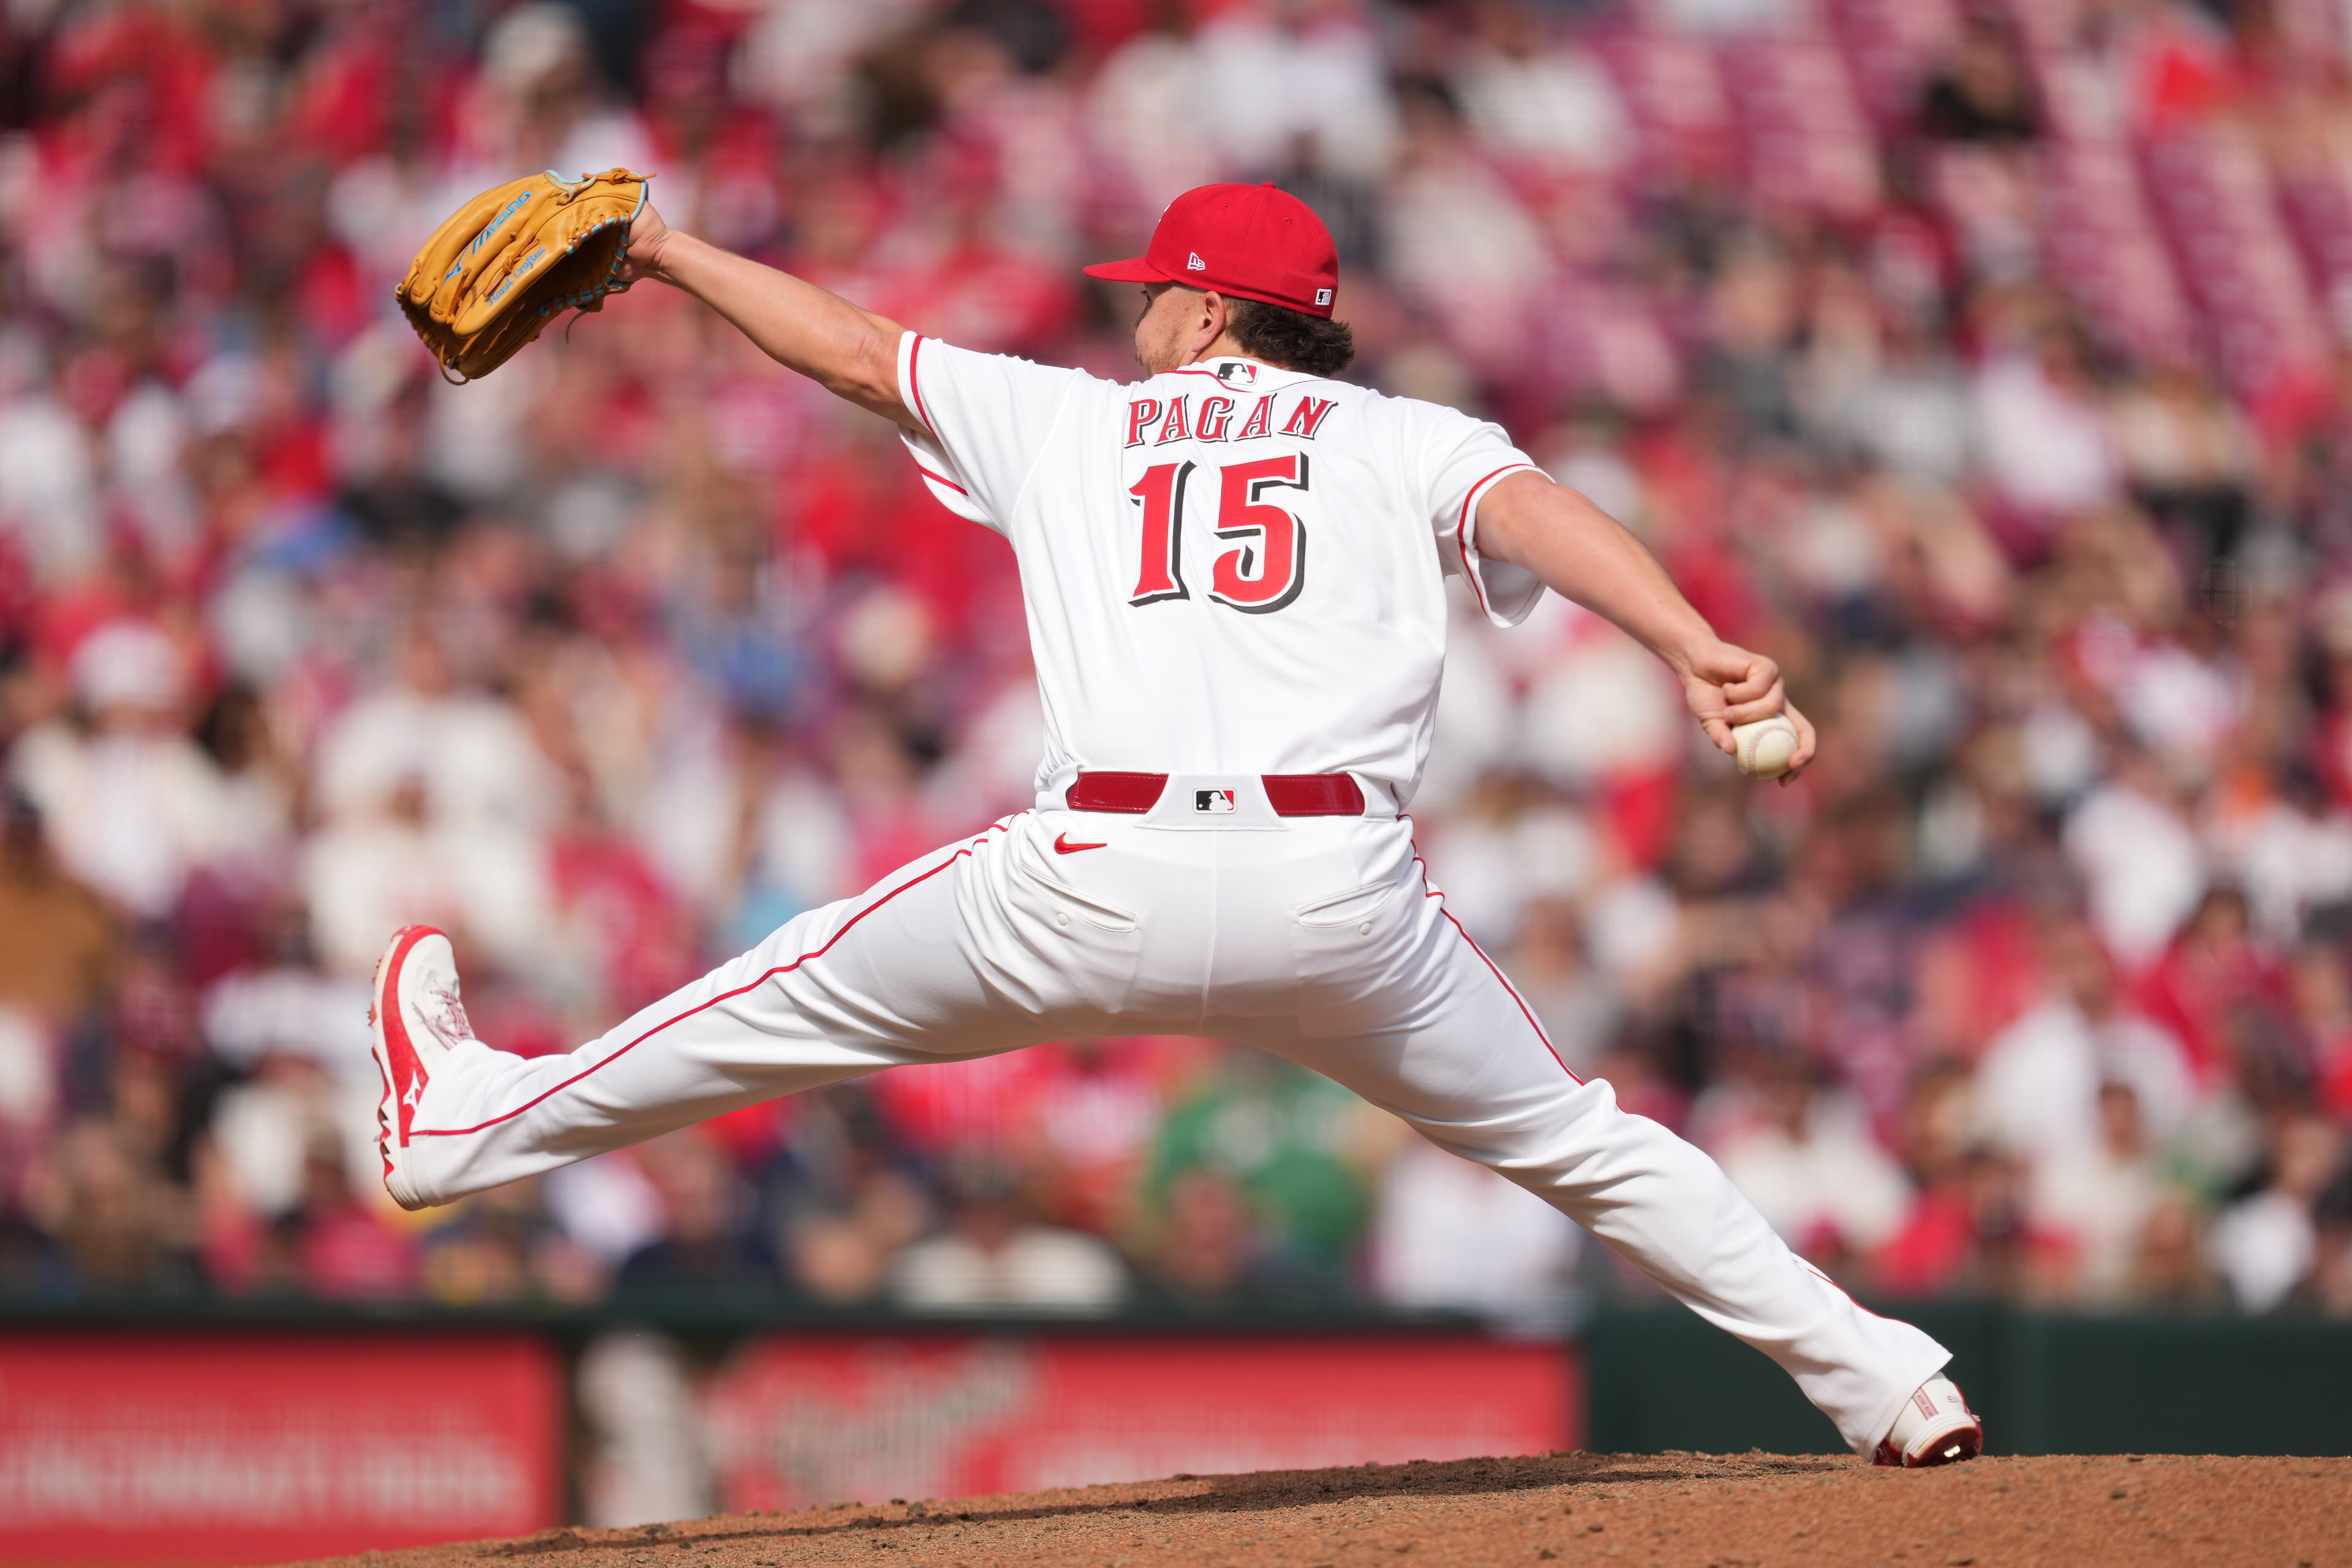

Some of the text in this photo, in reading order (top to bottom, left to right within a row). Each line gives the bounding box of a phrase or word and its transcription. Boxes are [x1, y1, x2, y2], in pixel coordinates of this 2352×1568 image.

[472, 190, 531, 256] MIZUNO
[488, 245, 545, 306] Hand Crafted
[1123, 392, 1339, 448] PAGAN
[1127, 451, 1310, 614] 15
